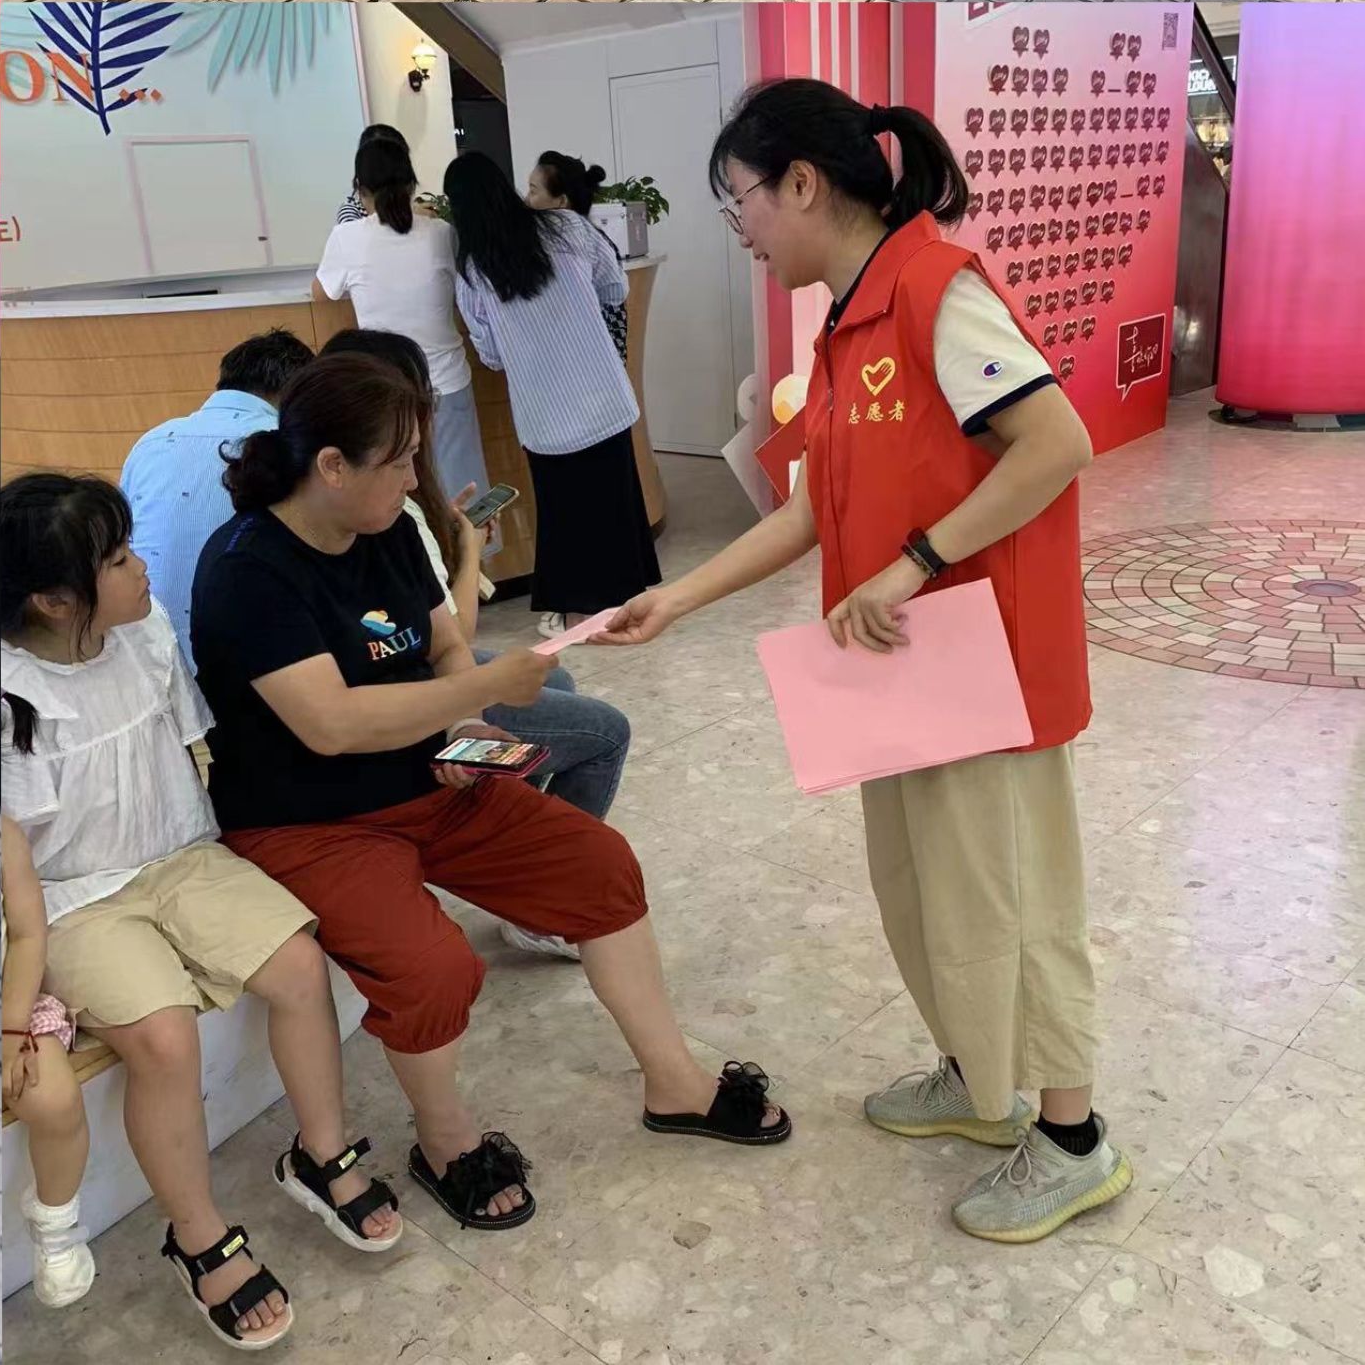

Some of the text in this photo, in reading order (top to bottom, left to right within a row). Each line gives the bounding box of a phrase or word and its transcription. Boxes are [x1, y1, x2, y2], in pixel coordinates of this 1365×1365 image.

[847, 399, 907, 425] 志愿者
[367, 626, 422, 662] PAUL
